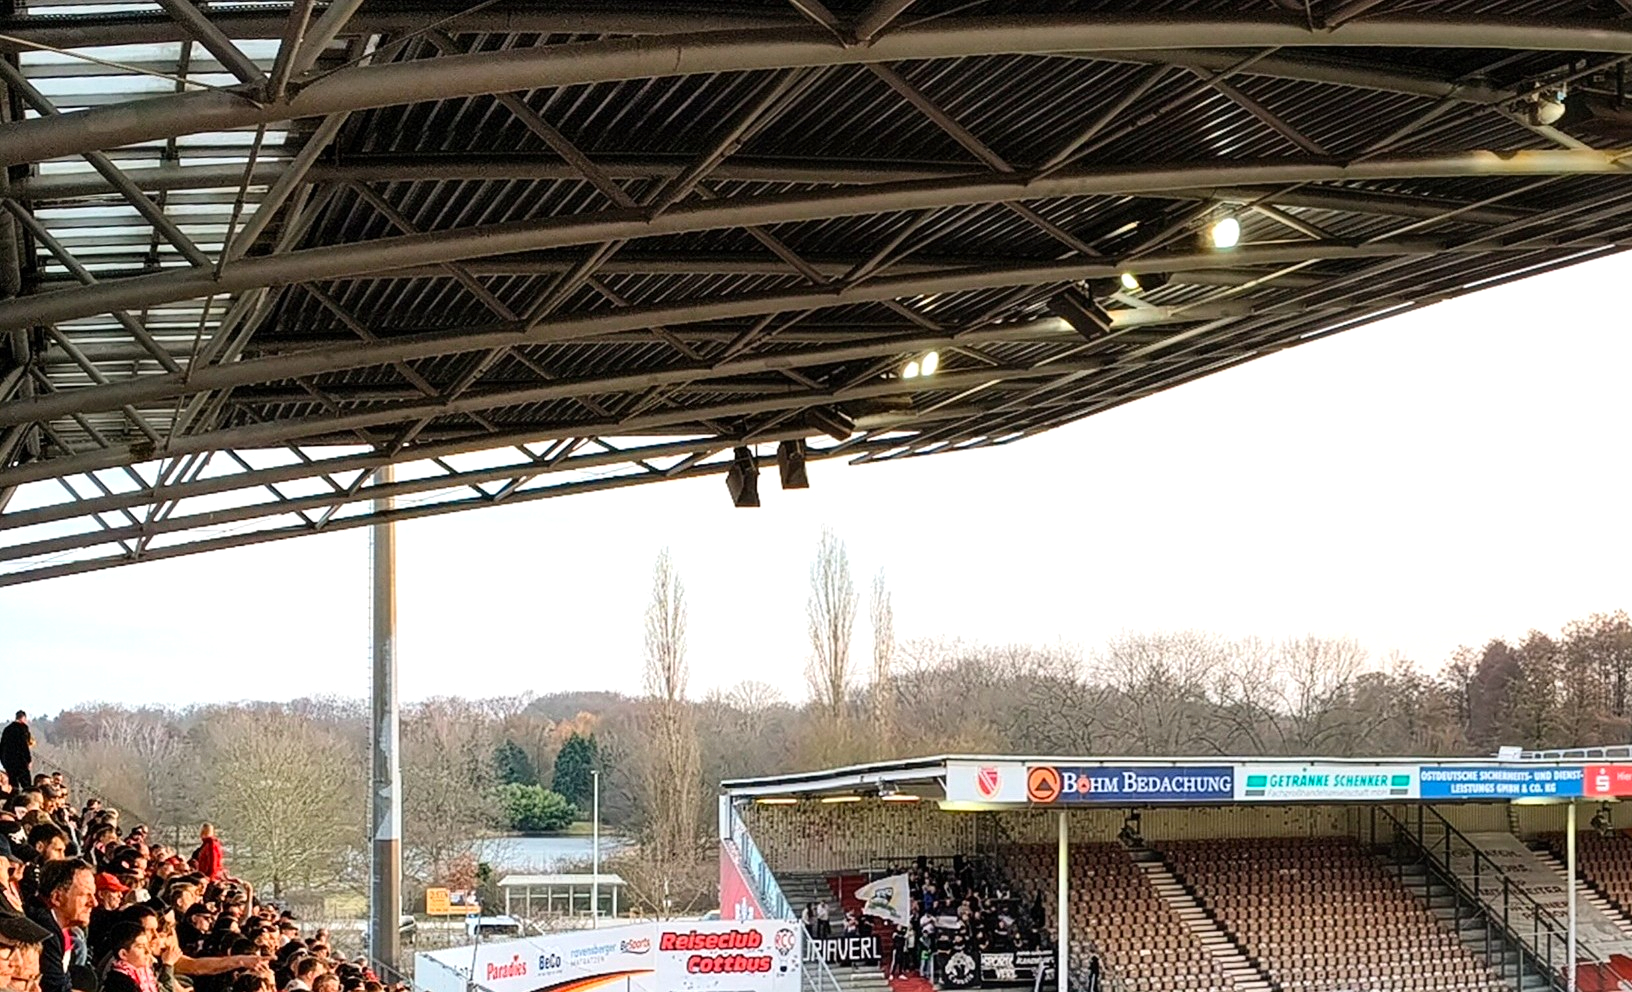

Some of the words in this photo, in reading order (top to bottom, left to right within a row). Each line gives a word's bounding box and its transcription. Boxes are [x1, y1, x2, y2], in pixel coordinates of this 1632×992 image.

[1122, 771, 1232, 793] BEDACHUNG
[1333, 774, 1389, 788] SCHENKER
[1420, 771, 1478, 781] OSTDEUTSCHE
[1534, 770, 1552, 781] UND
[1553, 770, 1584, 781] DIENST-
[1451, 782, 1495, 794] LEISTUNGS
[660, 930, 763, 951] Reiseclub
[486, 958, 527, 980] Paradies
[538, 953, 562, 970] BeCo
[687, 954, 774, 974] Cottbus
